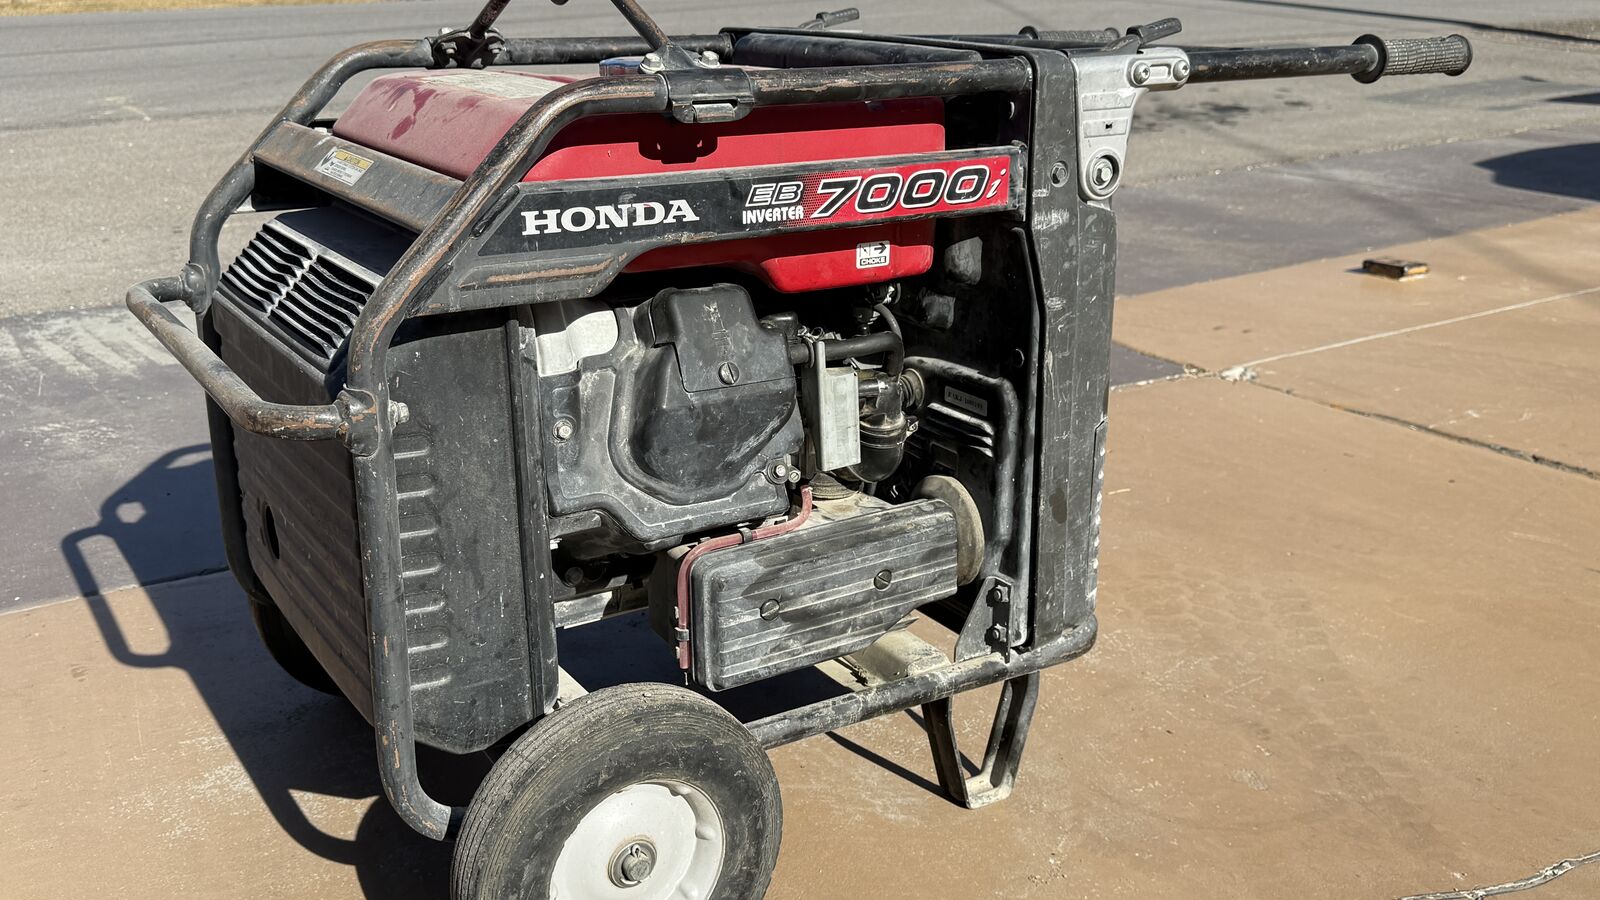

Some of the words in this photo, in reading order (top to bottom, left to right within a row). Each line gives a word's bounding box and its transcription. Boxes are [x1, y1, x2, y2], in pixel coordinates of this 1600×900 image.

[745, 181, 804, 207] EB
[520, 199, 700, 236] HONDA
[742, 205, 804, 224] INVERTER
[860, 256, 886, 266] CHOKE
